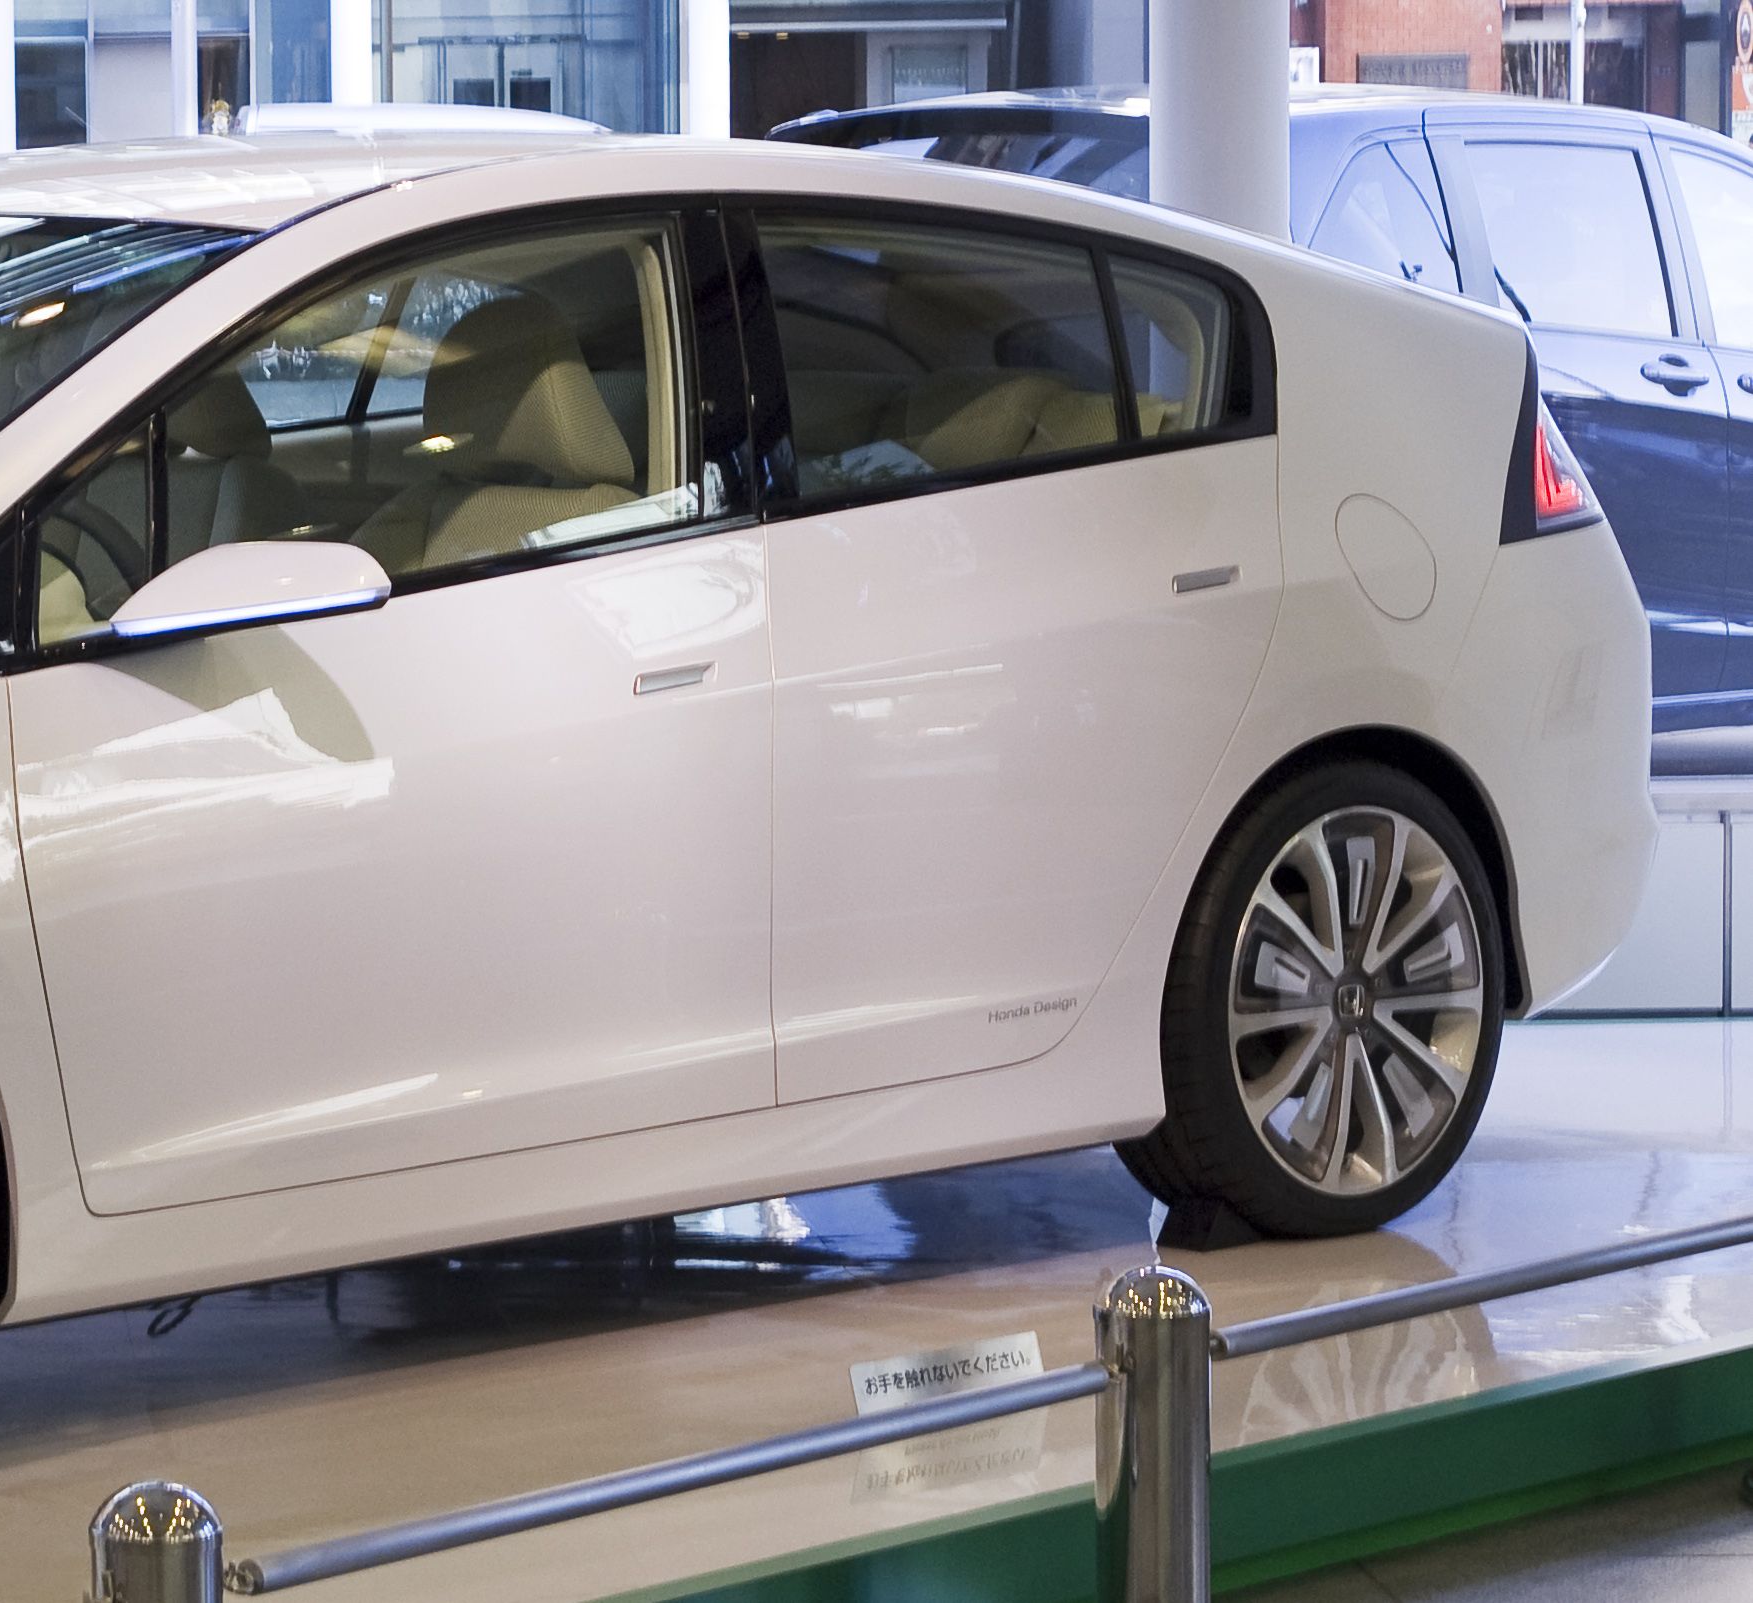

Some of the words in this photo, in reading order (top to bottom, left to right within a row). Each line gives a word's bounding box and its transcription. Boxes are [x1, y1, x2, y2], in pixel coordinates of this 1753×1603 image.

[988, 1004, 1030, 1024] Honda
[1033, 997, 1078, 1014] Design
[864, 1350, 1031, 1395] お手を触れないでください。
